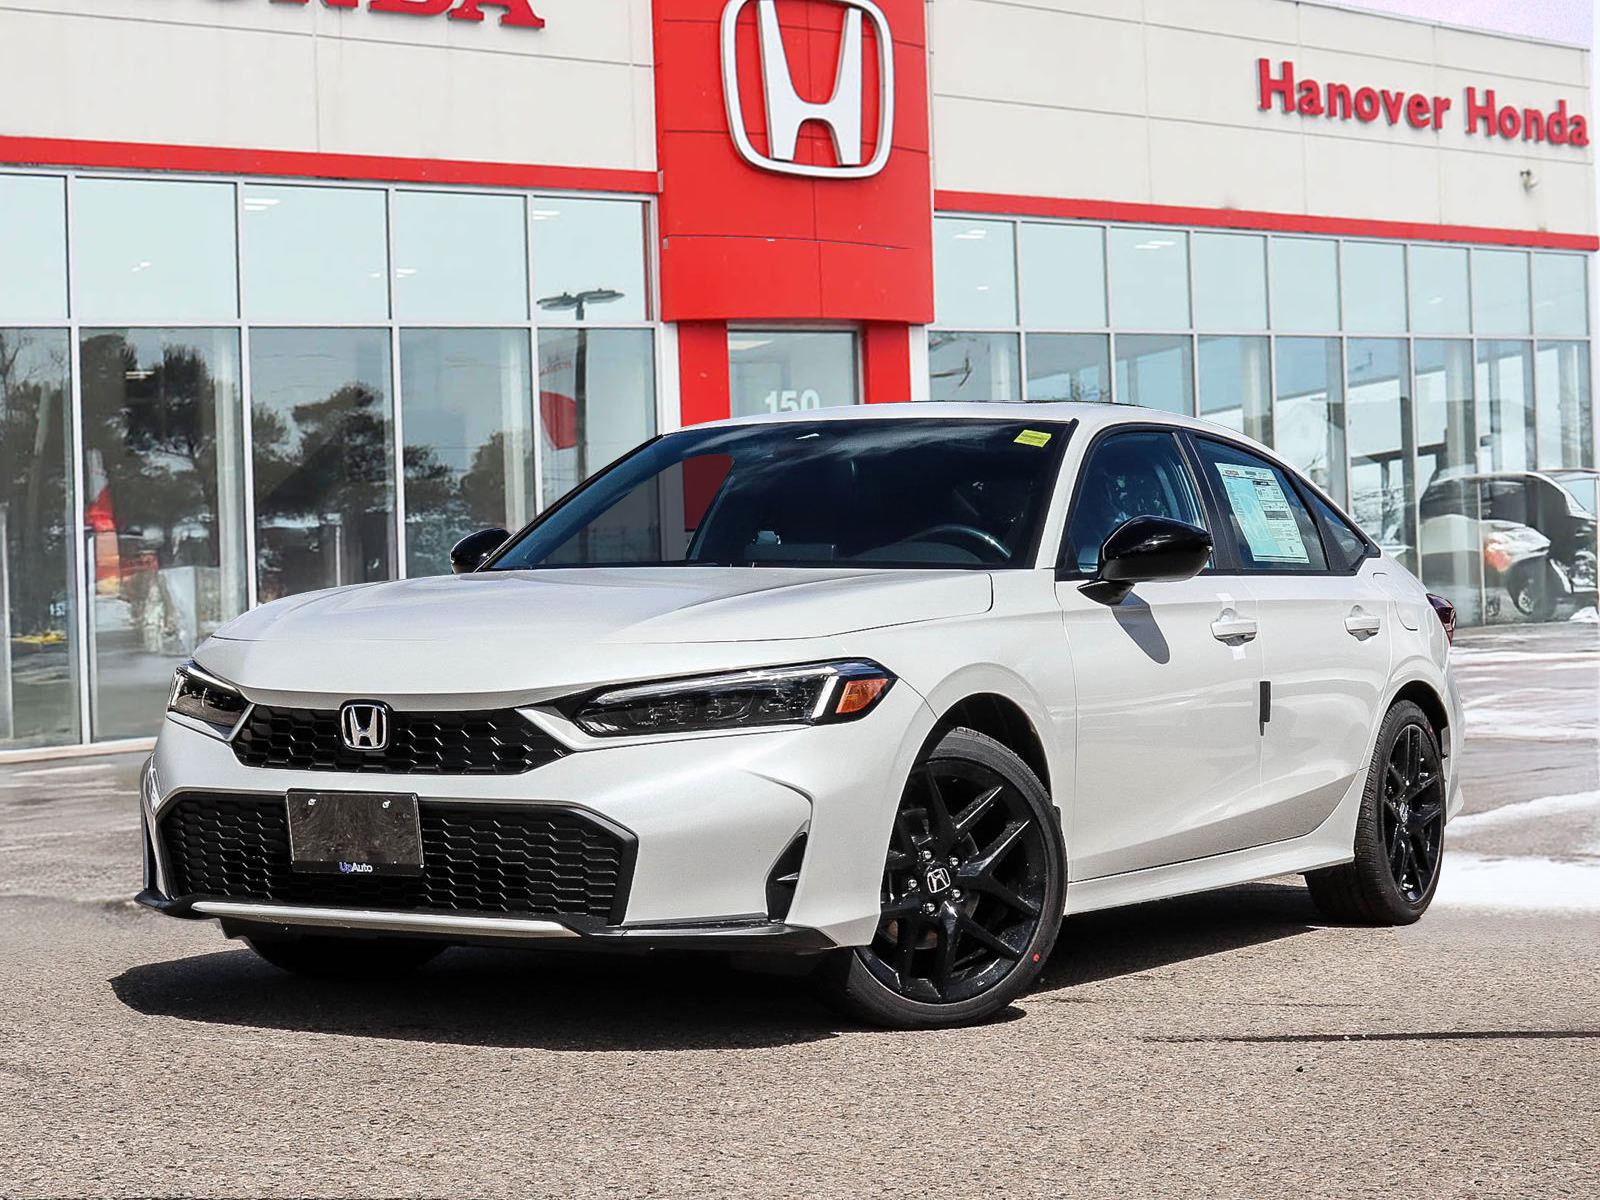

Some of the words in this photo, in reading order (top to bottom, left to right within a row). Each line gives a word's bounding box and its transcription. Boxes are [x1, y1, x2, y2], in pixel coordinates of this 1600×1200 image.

[1258, 57, 1452, 130] Hanover
[1465, 86, 1590, 147] Honda
[764, 388, 820, 414] 150
[339, 861, 373, 874] UpAuto
